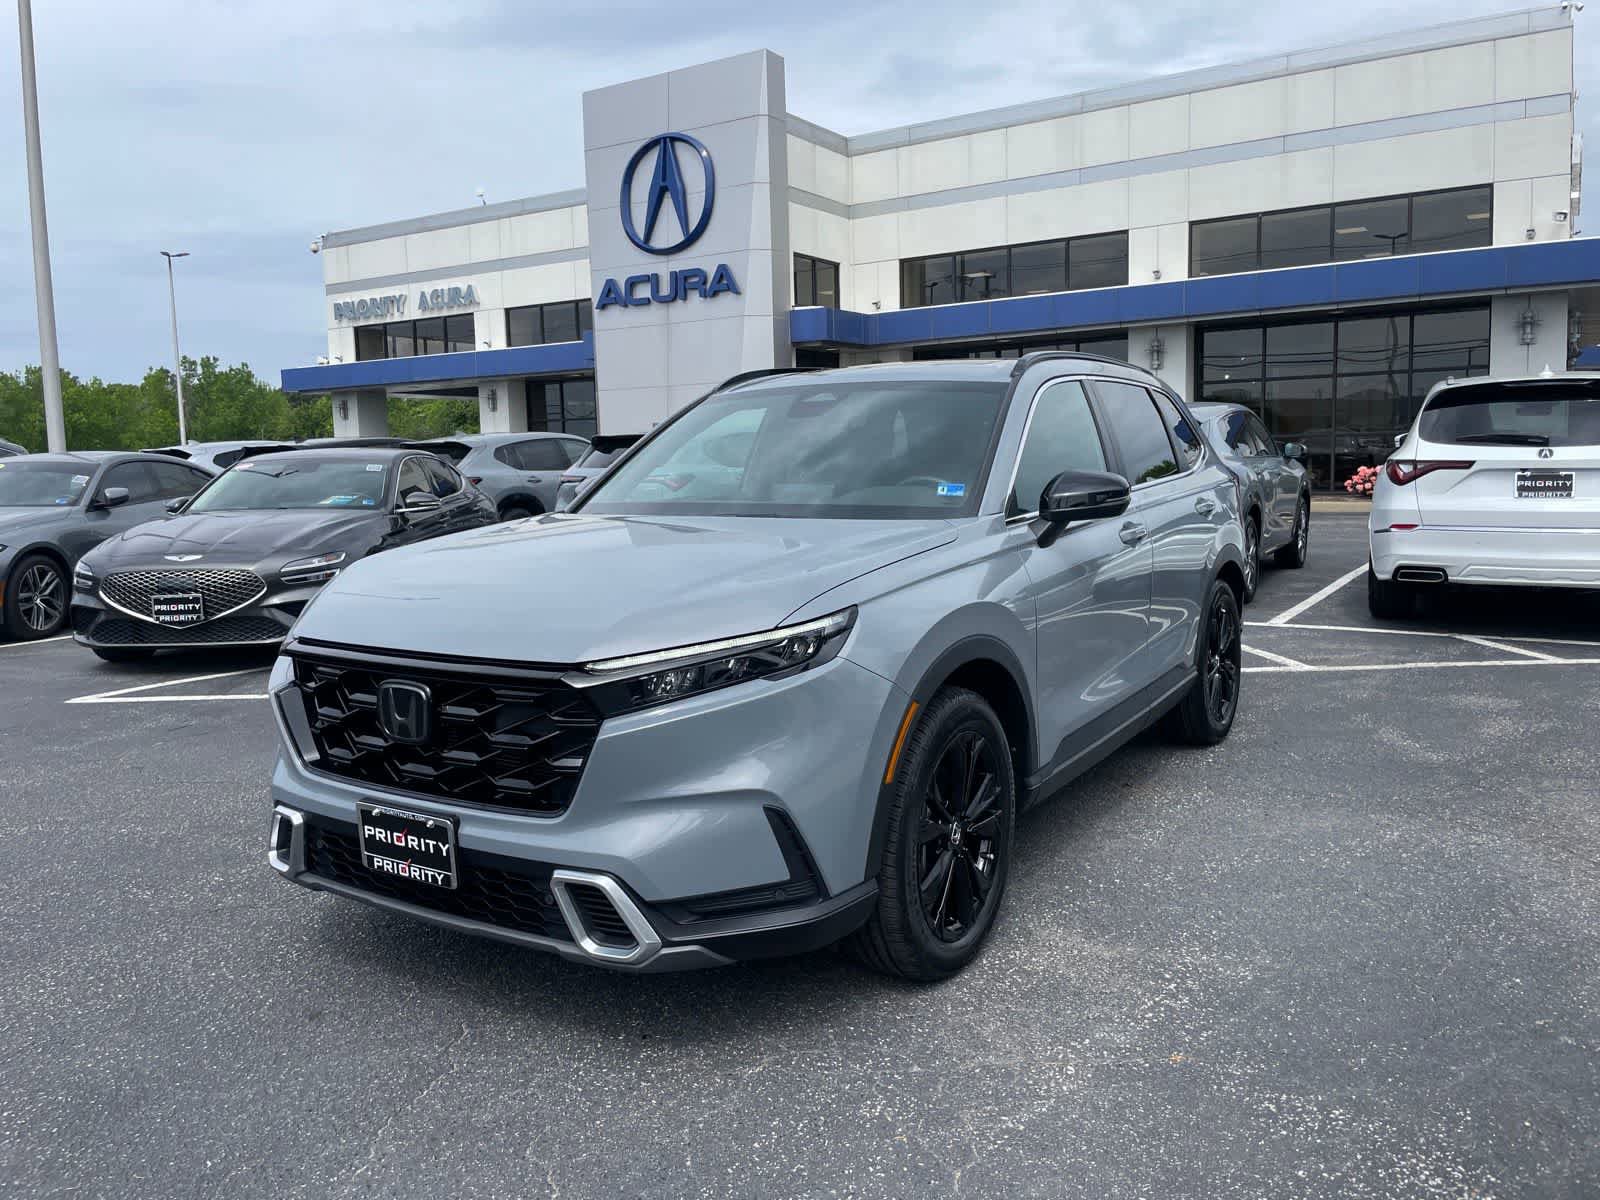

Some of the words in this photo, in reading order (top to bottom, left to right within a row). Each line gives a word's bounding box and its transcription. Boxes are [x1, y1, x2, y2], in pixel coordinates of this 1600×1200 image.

[595, 263, 742, 310] ACURA
[333, 293, 408, 322] PRIORITY
[417, 284, 480, 313] ACURA
[154, 602, 201, 611] PRIORITY
[364, 825, 449, 857] PRIORITY
[373, 857, 444, 885] PRIORITY
